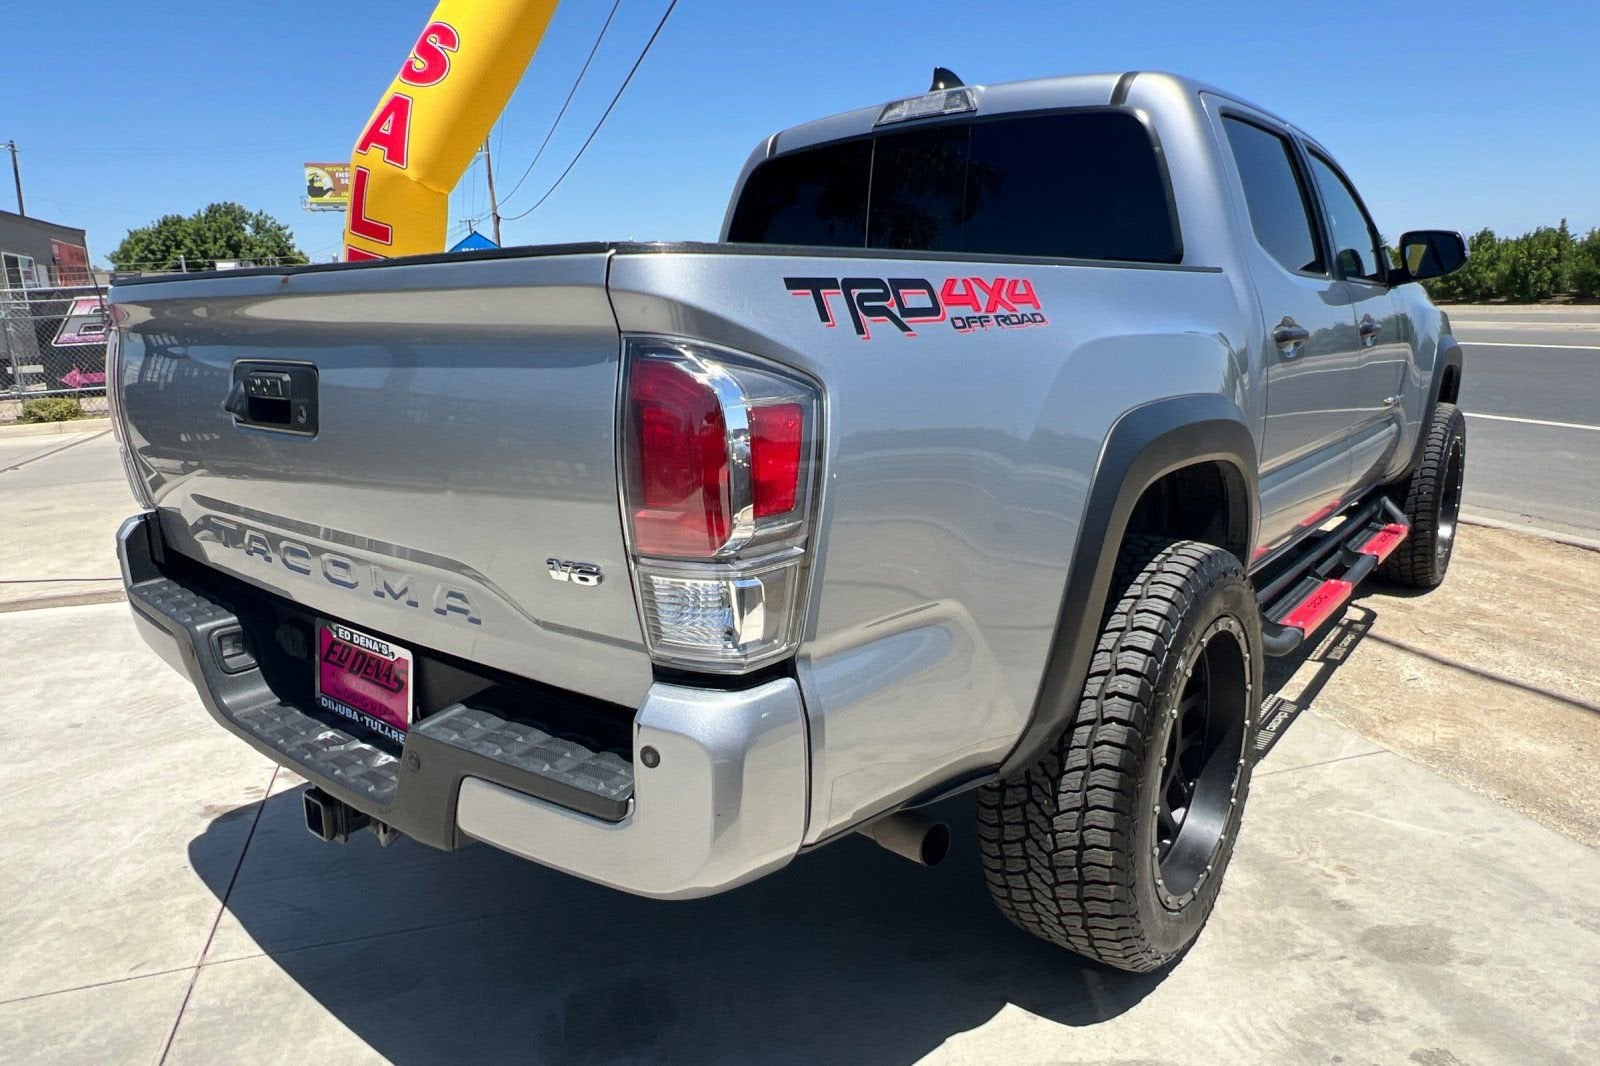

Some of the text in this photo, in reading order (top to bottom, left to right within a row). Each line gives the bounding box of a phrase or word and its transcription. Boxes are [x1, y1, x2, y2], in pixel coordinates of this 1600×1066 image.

[345, 21, 459, 262] SAL
[783, 276, 1041, 340] TRD 4X4
[951, 312, 1047, 332] OFF ROAD
[209, 516, 482, 625] TACOMA
[546, 558, 603, 587] V6
[325, 641, 352, 669] ED
[338, 627, 388, 656] ED DENA'S
[321, 697, 359, 722] DINUBA
[364, 716, 405, 743] TULARE
